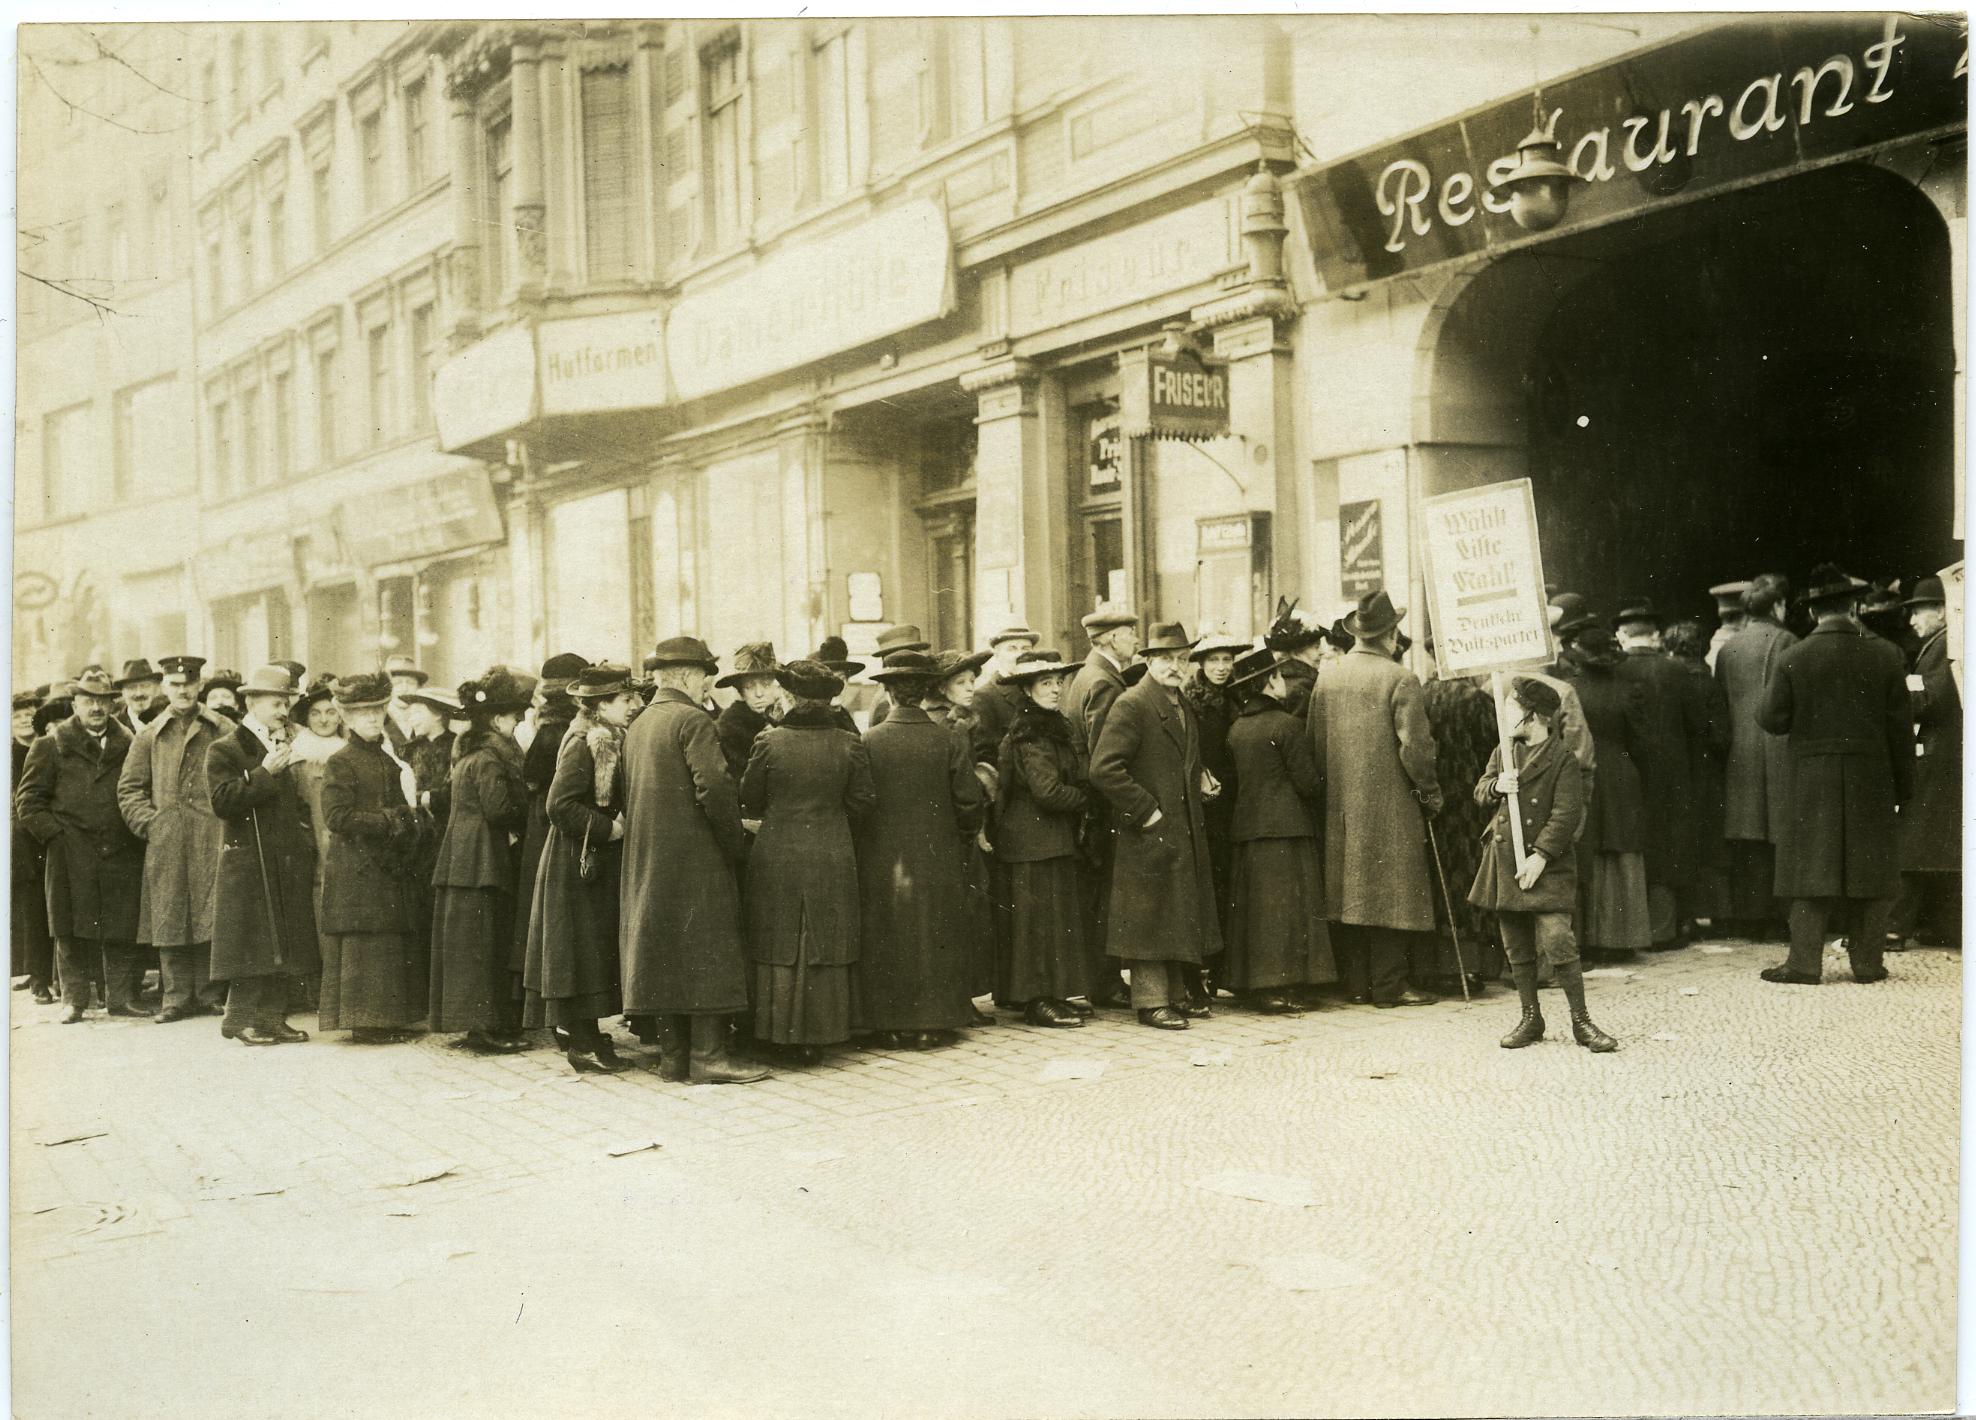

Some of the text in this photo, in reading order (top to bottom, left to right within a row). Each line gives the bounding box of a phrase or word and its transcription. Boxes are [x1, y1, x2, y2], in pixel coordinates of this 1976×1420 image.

[1376, 14, 1906, 252] Resaurant
[547, 342, 657, 384] Hutformen
[1154, 366, 1225, 408] FRISEUR
[1455, 534, 1502, 561] Liste
